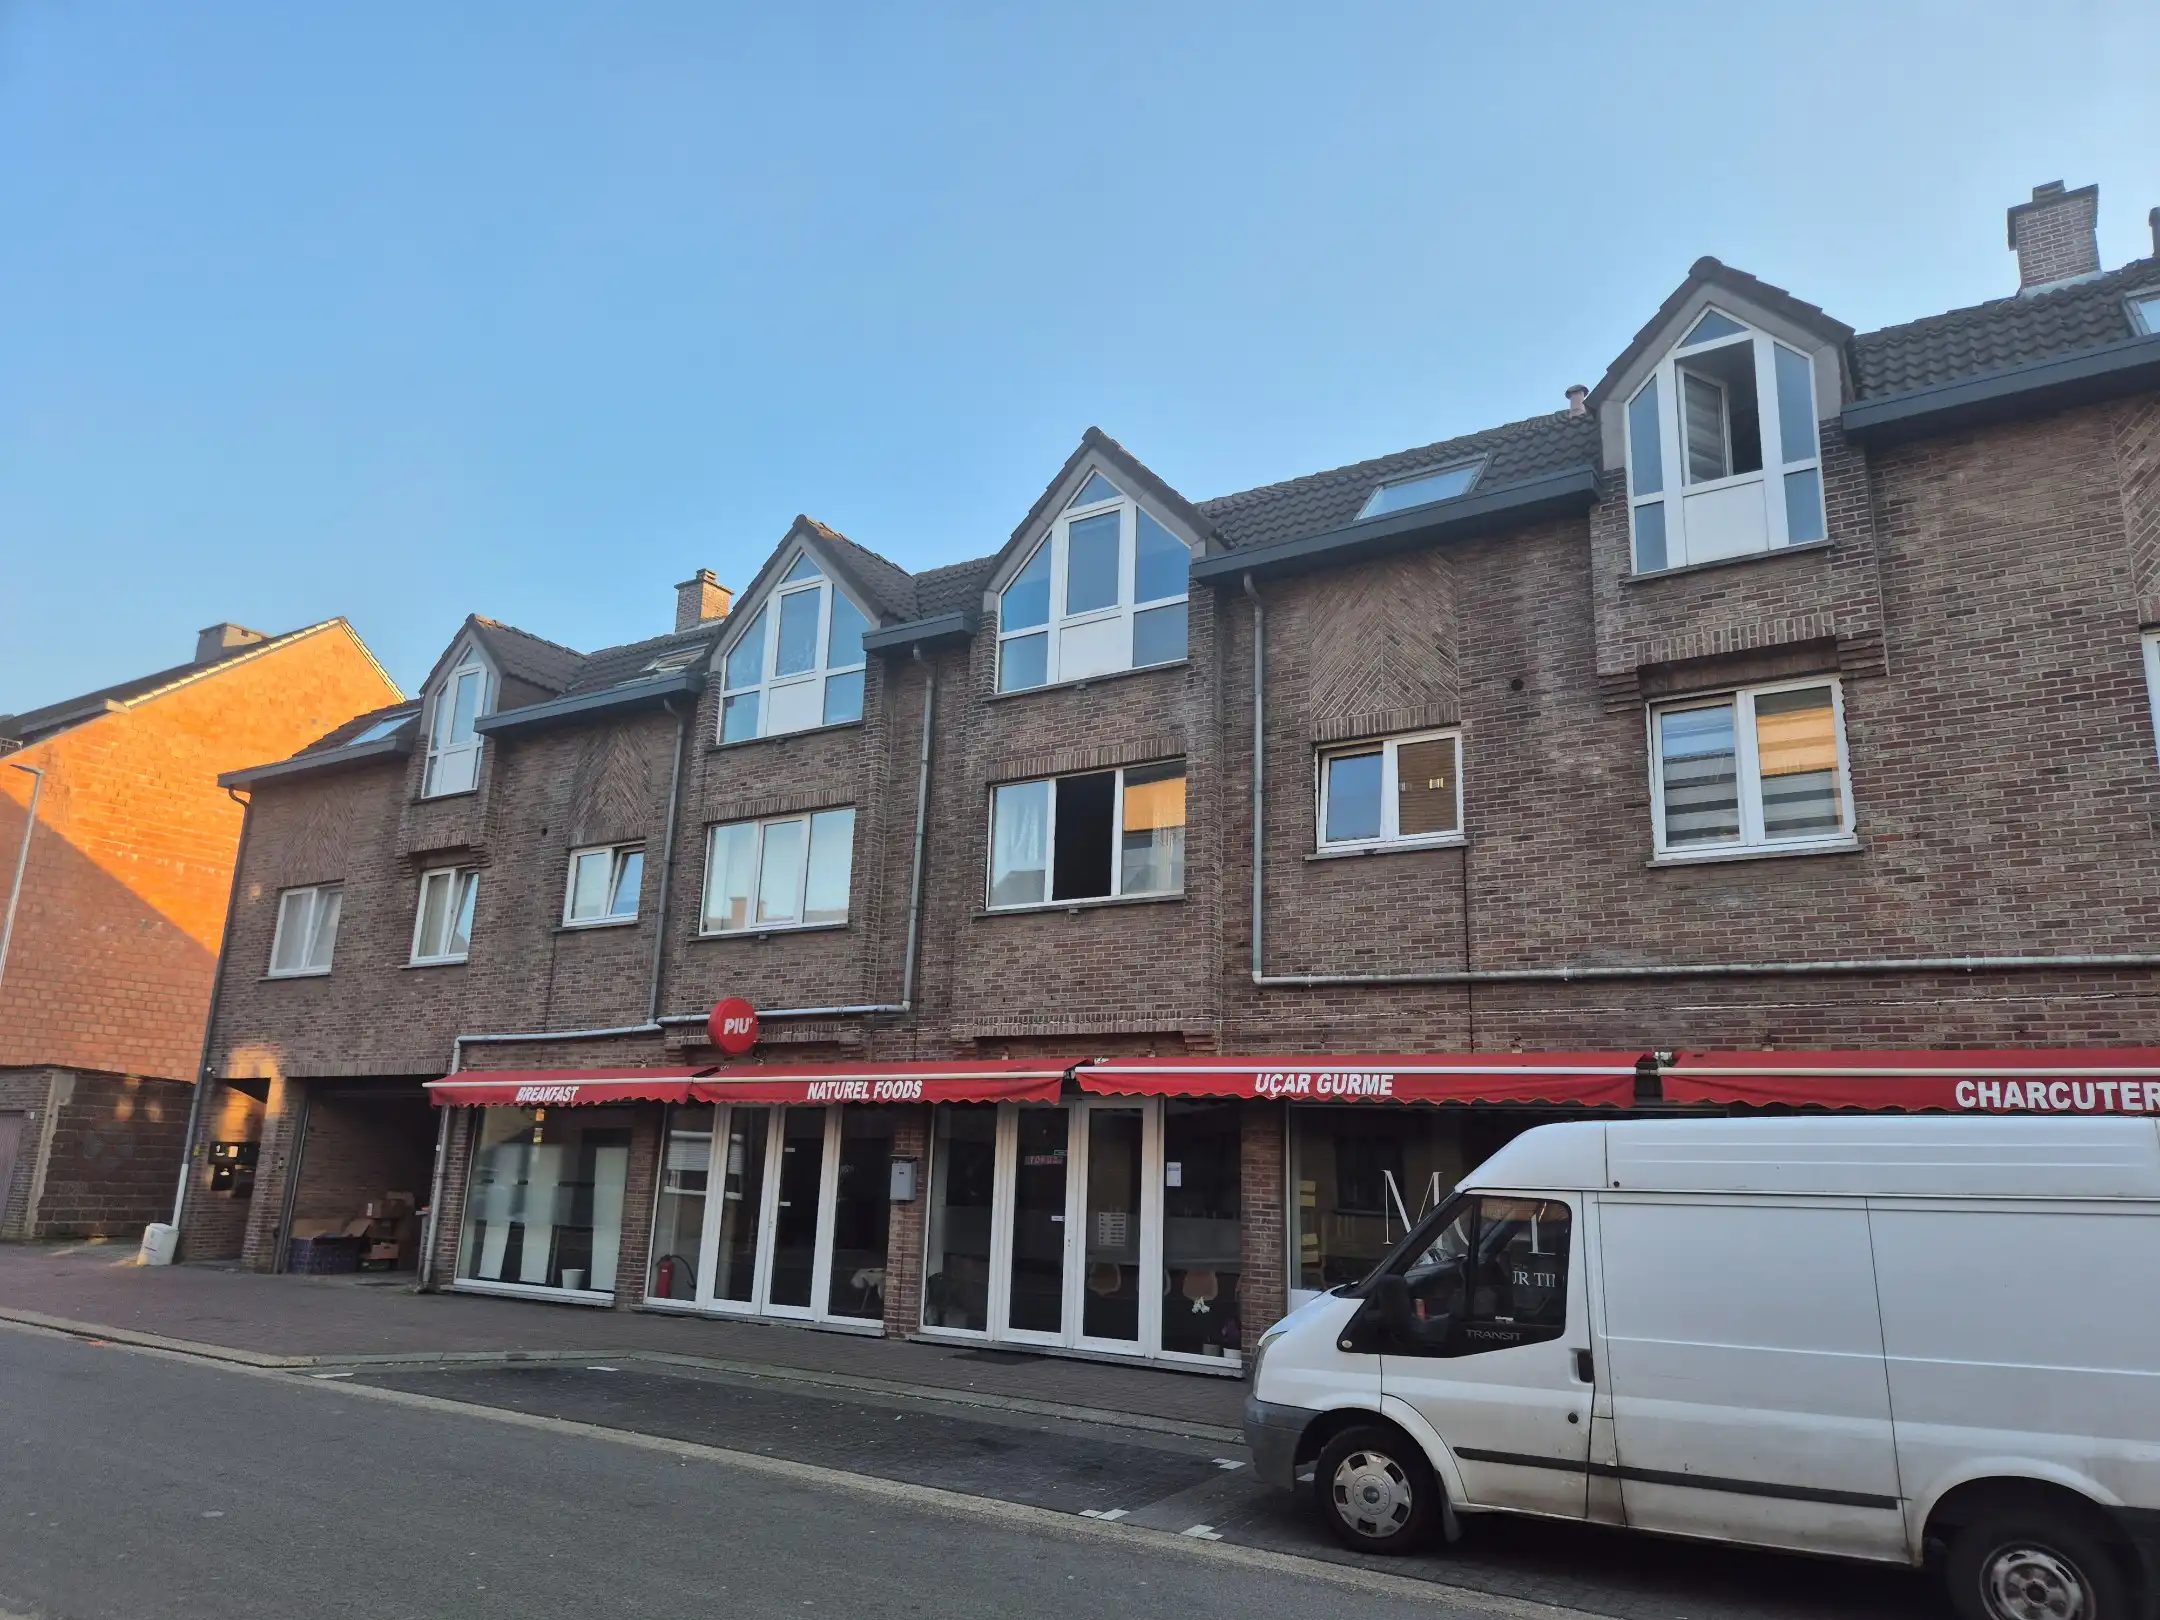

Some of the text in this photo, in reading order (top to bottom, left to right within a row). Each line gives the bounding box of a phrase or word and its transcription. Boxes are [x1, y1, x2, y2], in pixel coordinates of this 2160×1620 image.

[515, 1085, 580, 1102] BREAKFAST
[806, 1080, 923, 1100] NATUREL FOODS
[1254, 1073, 1394, 1098] UÇAR GURME
[1465, 1329, 1521, 1341] TRANSIT
